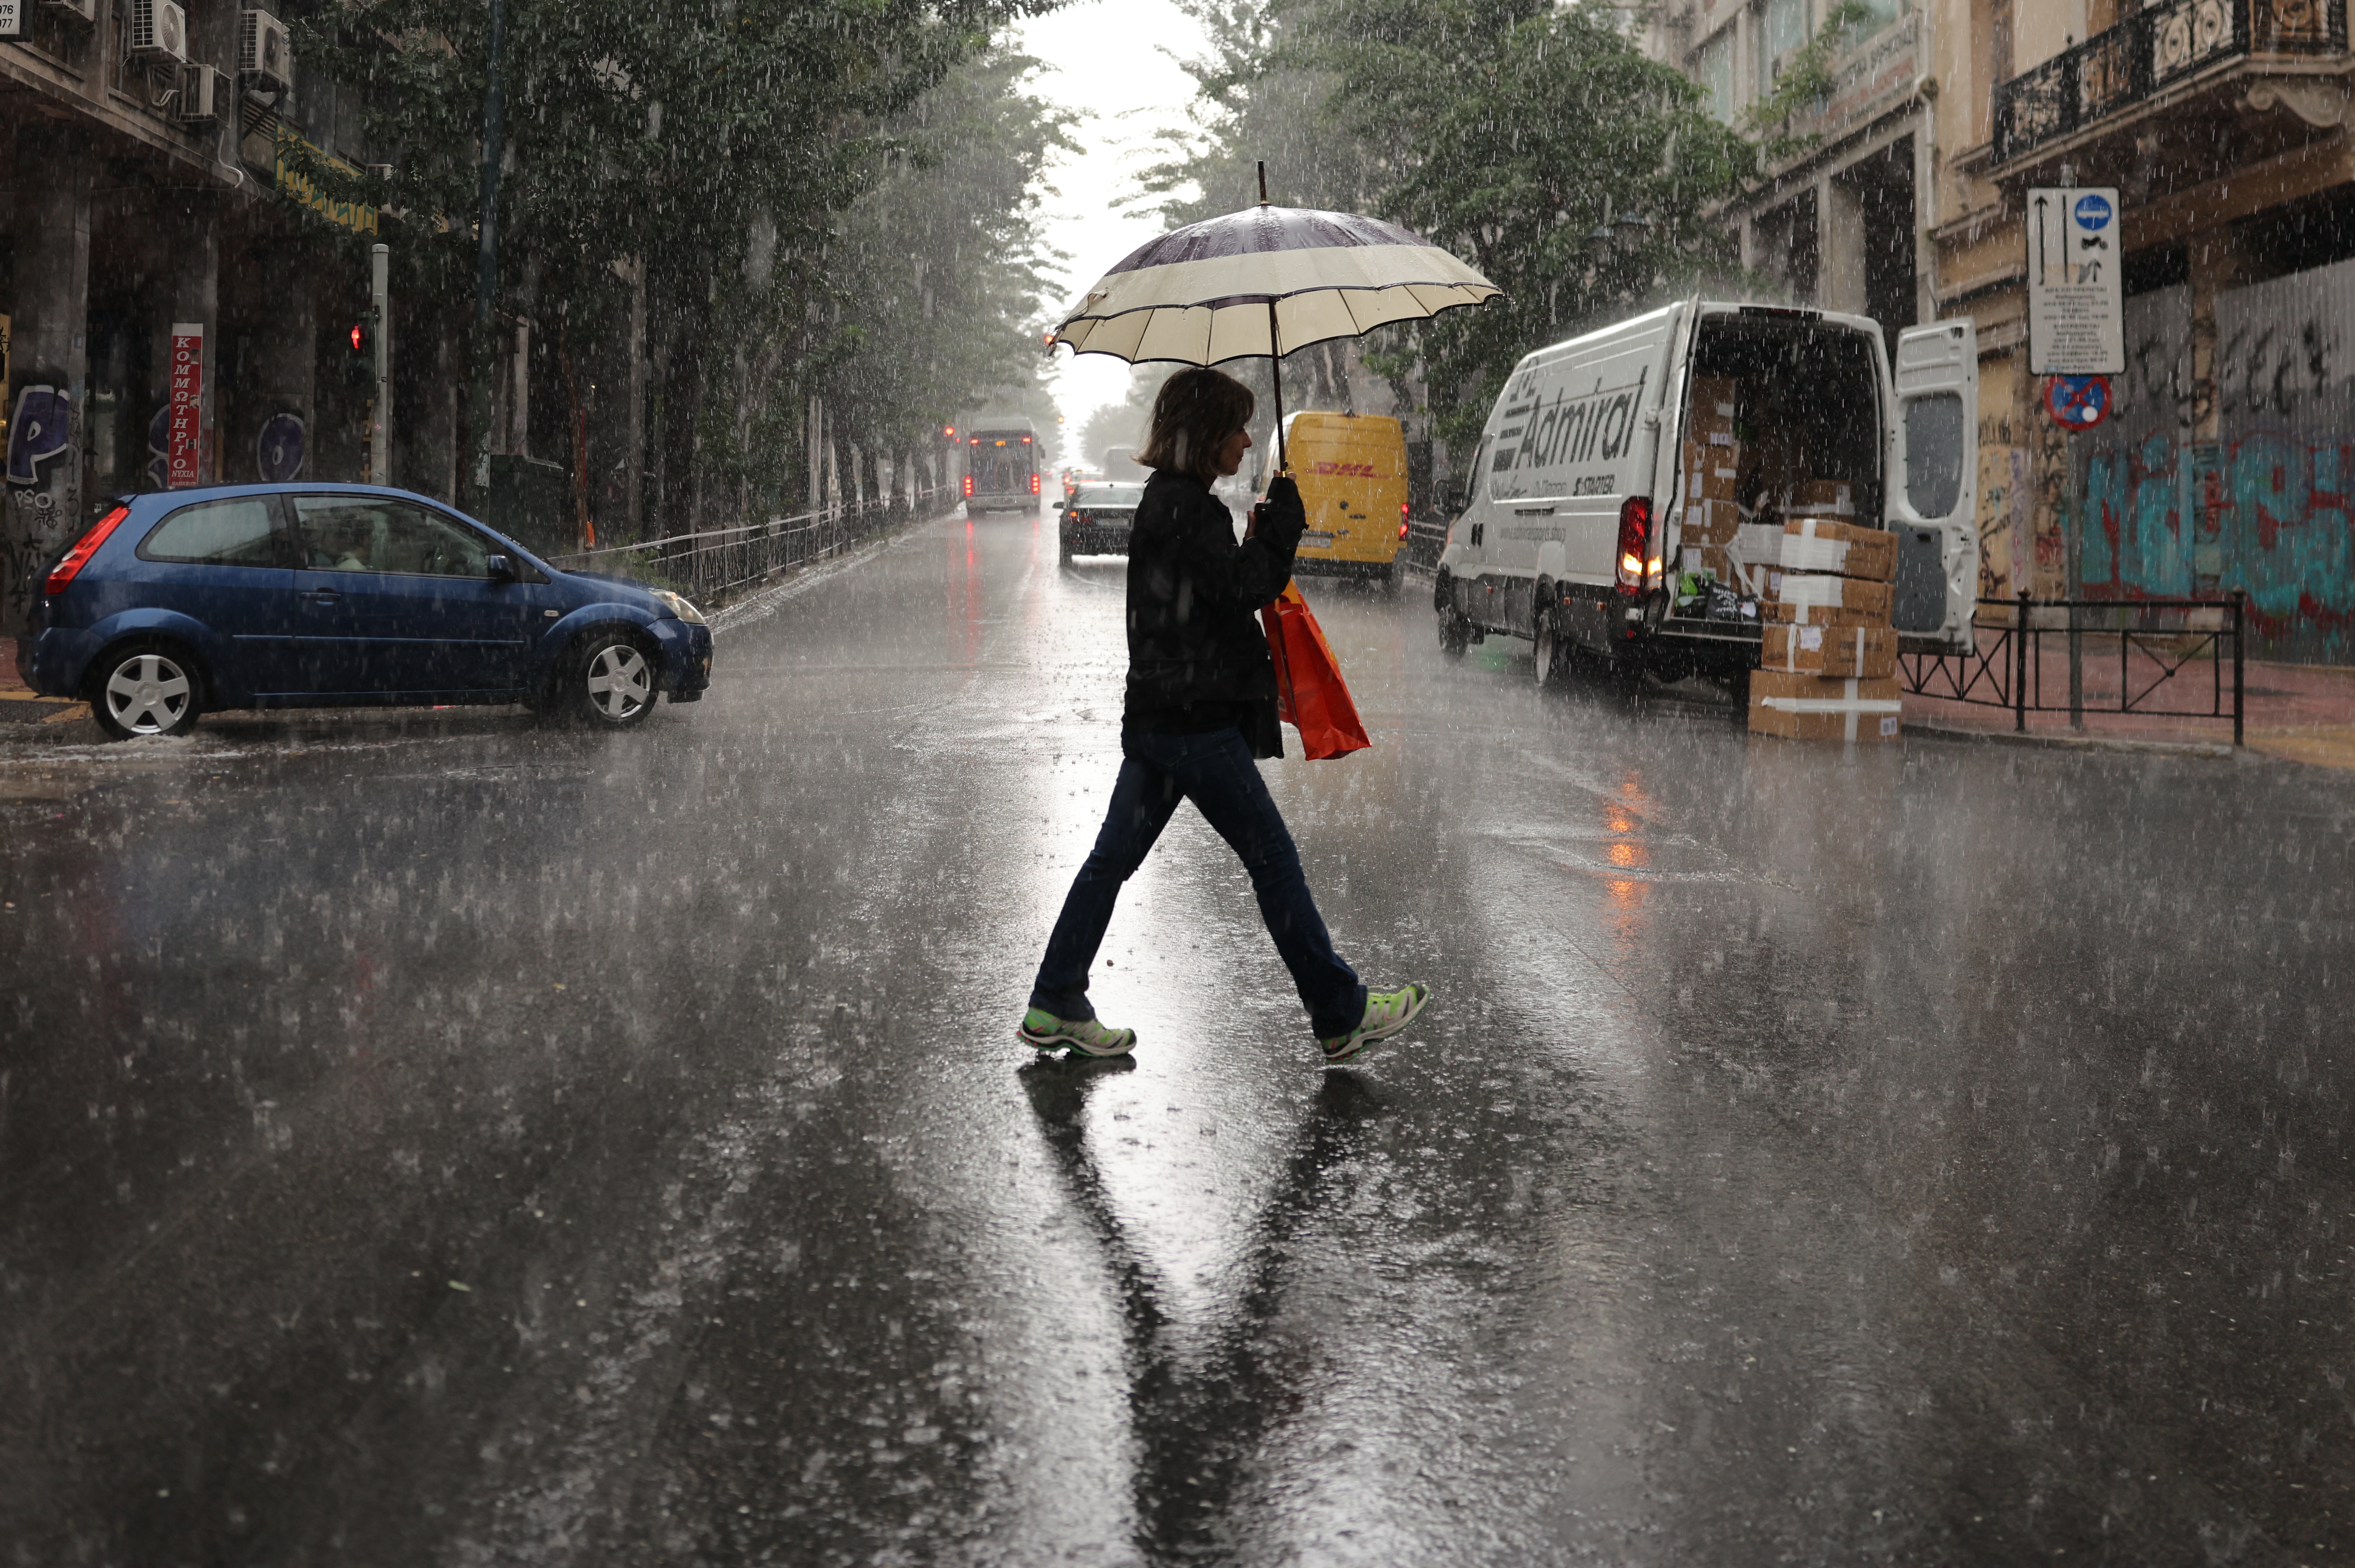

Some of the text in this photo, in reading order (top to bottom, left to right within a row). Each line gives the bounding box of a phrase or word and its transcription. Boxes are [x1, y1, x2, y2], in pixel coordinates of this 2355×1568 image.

[0, 19, 13, 28] 77
[173, 337, 190, 469] ΚΟΜΜΩΤΗΡΙΟ
[1516, 366, 1648, 470] Admiral
[1317, 461, 1373, 477] DHL
[1583, 475, 1615, 496] STARTER
